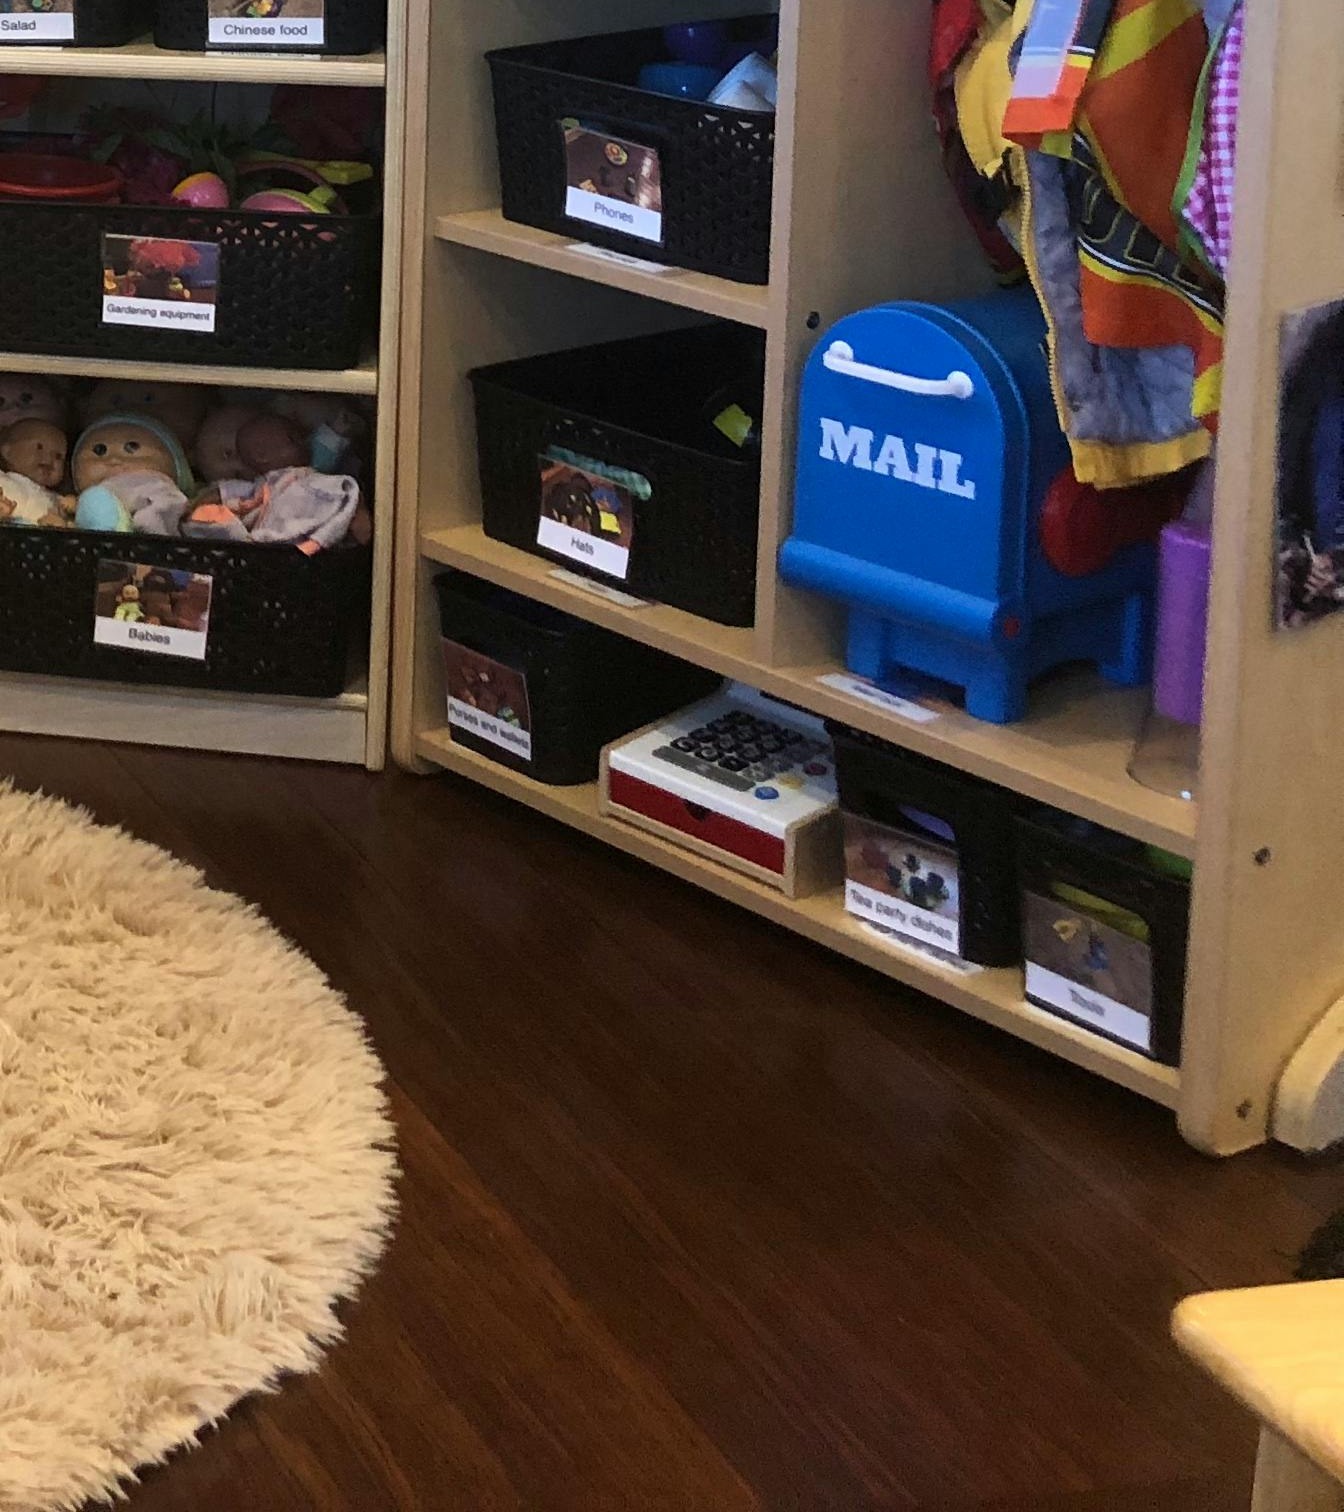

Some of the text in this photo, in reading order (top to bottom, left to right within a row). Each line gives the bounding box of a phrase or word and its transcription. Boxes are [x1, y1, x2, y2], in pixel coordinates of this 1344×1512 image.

[1, 19, 37, 31] Salad
[223, 24, 308, 36] Chinese food
[594, 201, 634, 224] Phones
[106, 303, 210, 321] Gardening equipment
[819, 417, 975, 501] MAIL
[571, 536, 594, 556] Hats
[128, 628, 171, 645] Babies
